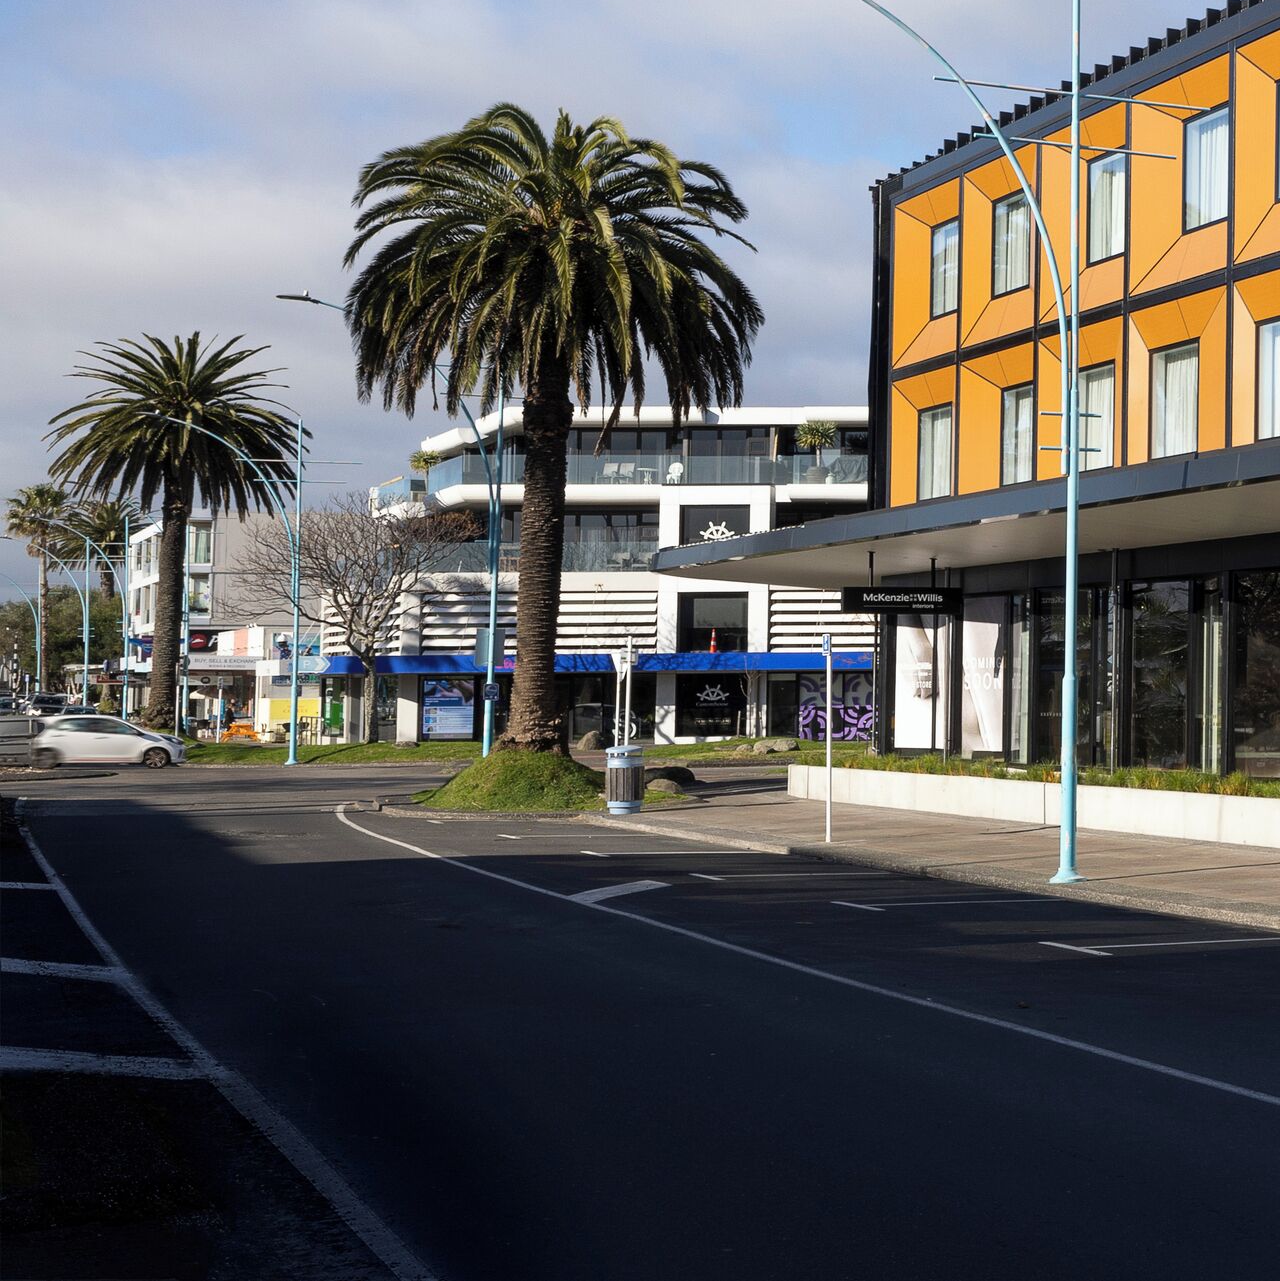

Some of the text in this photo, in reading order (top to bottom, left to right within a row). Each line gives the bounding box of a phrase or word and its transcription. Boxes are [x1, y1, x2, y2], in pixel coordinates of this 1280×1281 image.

[863, 593, 943, 602] McKenzie Willis
[963, 672, 1003, 690] SOON
